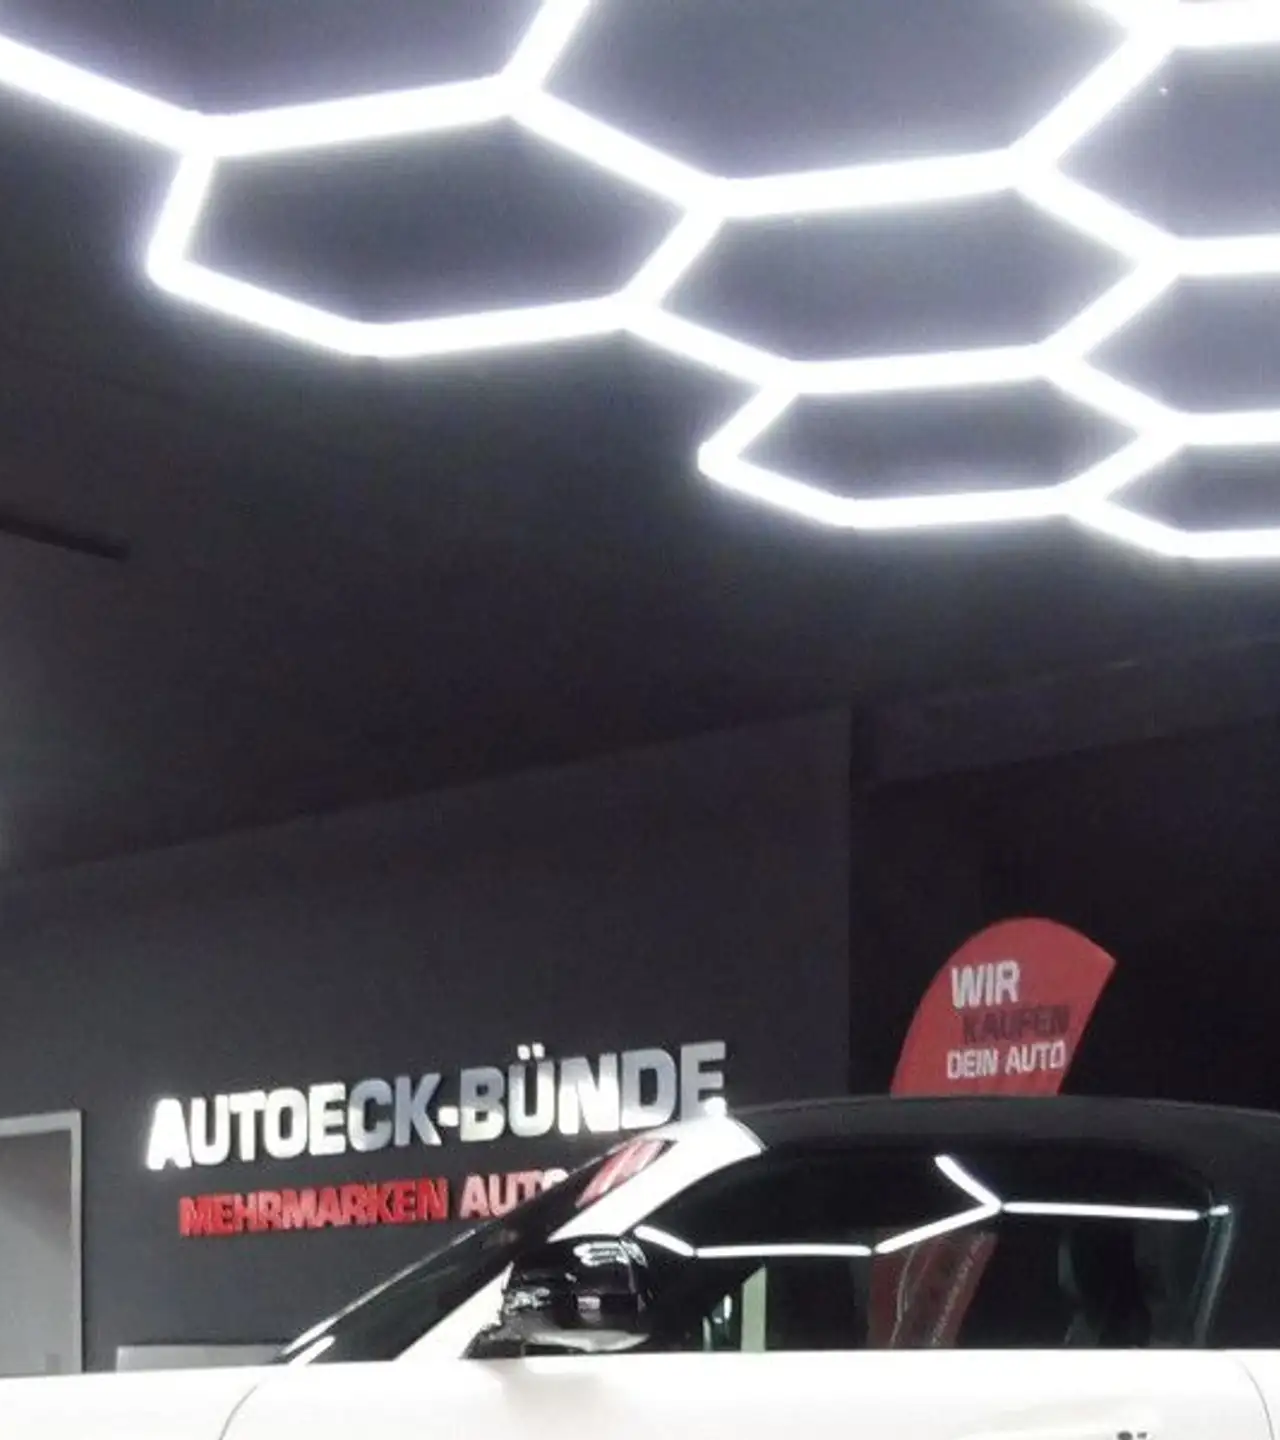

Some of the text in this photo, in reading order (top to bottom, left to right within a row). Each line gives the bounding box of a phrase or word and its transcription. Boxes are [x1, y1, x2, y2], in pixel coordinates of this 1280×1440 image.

[950, 960, 1020, 1009] WIR
[962, 1004, 1070, 1044] KAUFEN
[946, 1039, 1067, 1079] DEIN AUTO
[146, 1042, 726, 1170] AUTOECK-BÜNDE
[179, 1177, 449, 1237] MEHRMARKEN
